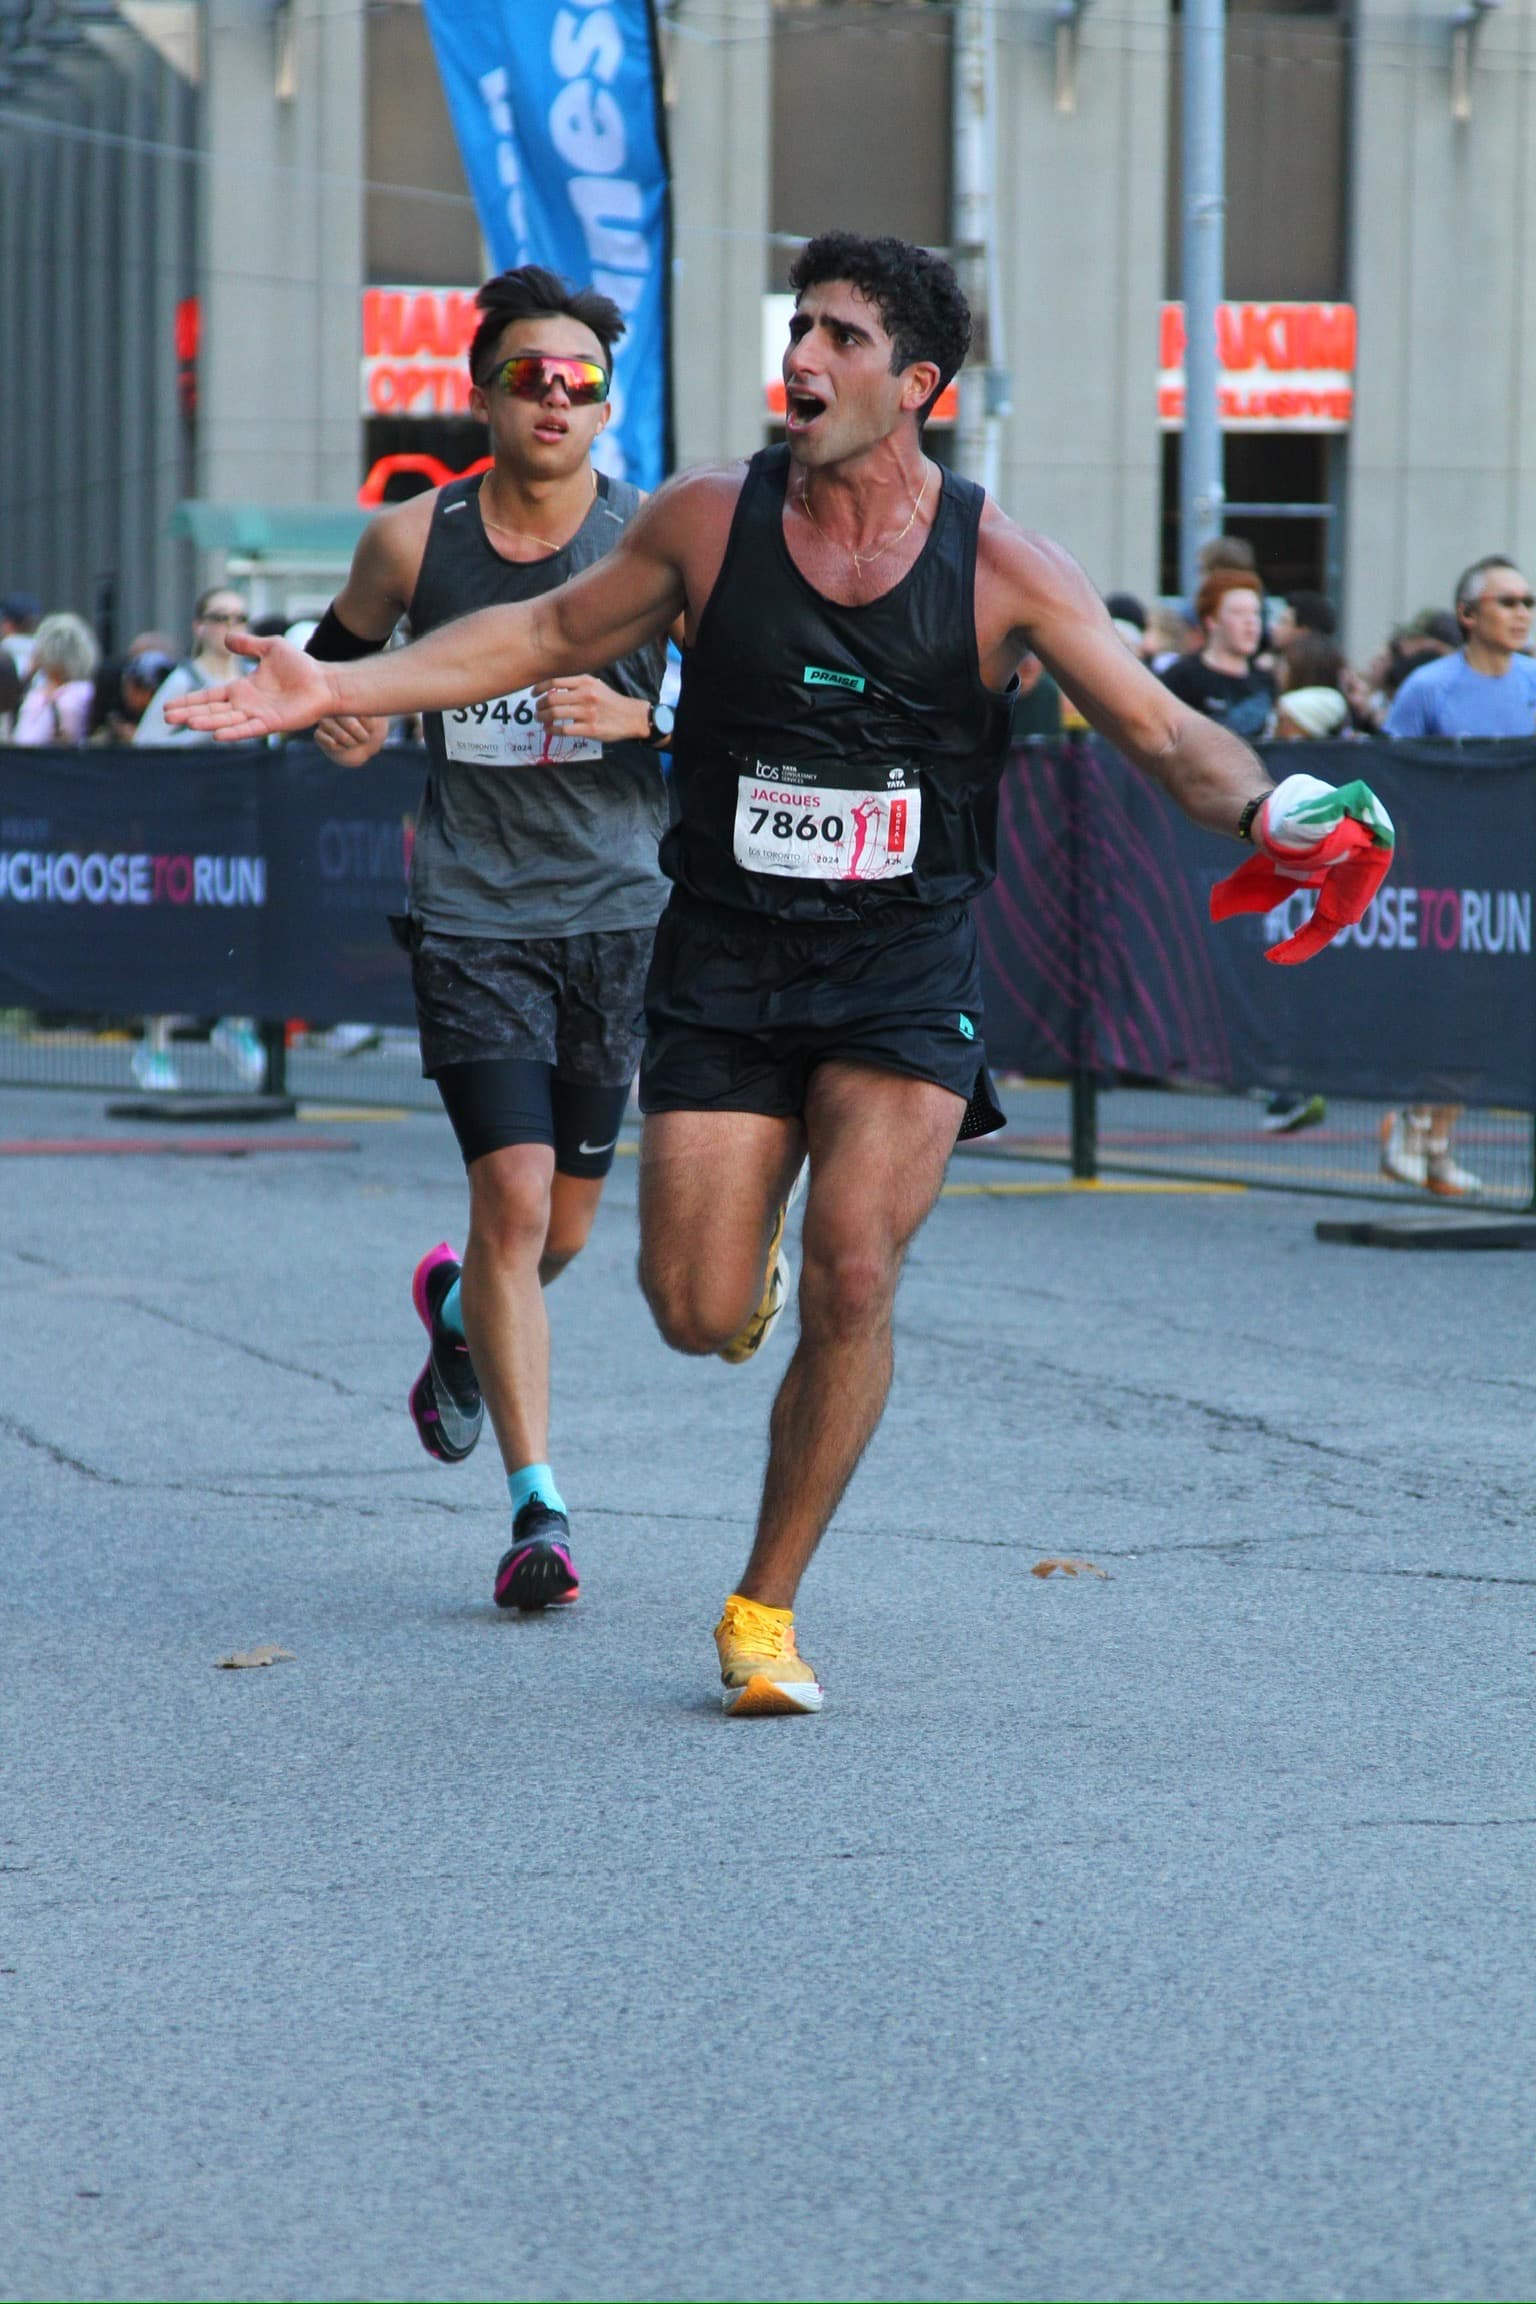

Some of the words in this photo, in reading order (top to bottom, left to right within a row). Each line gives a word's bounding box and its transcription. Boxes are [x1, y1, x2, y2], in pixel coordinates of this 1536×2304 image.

[363, 288, 482, 357] HAK
[811, 671, 859, 688] PRAISE
[750, 788, 821, 808] JACQUES
[887, 780, 906, 789] TATA
[749, 807, 844, 843] 7860
[762, 850, 801, 861] TORONTO
[816, 855, 839, 864] 2024
[0, 852, 266, 905] CHOOSETORUN
[1264, 887, 1531, 953] #COSETORUN
